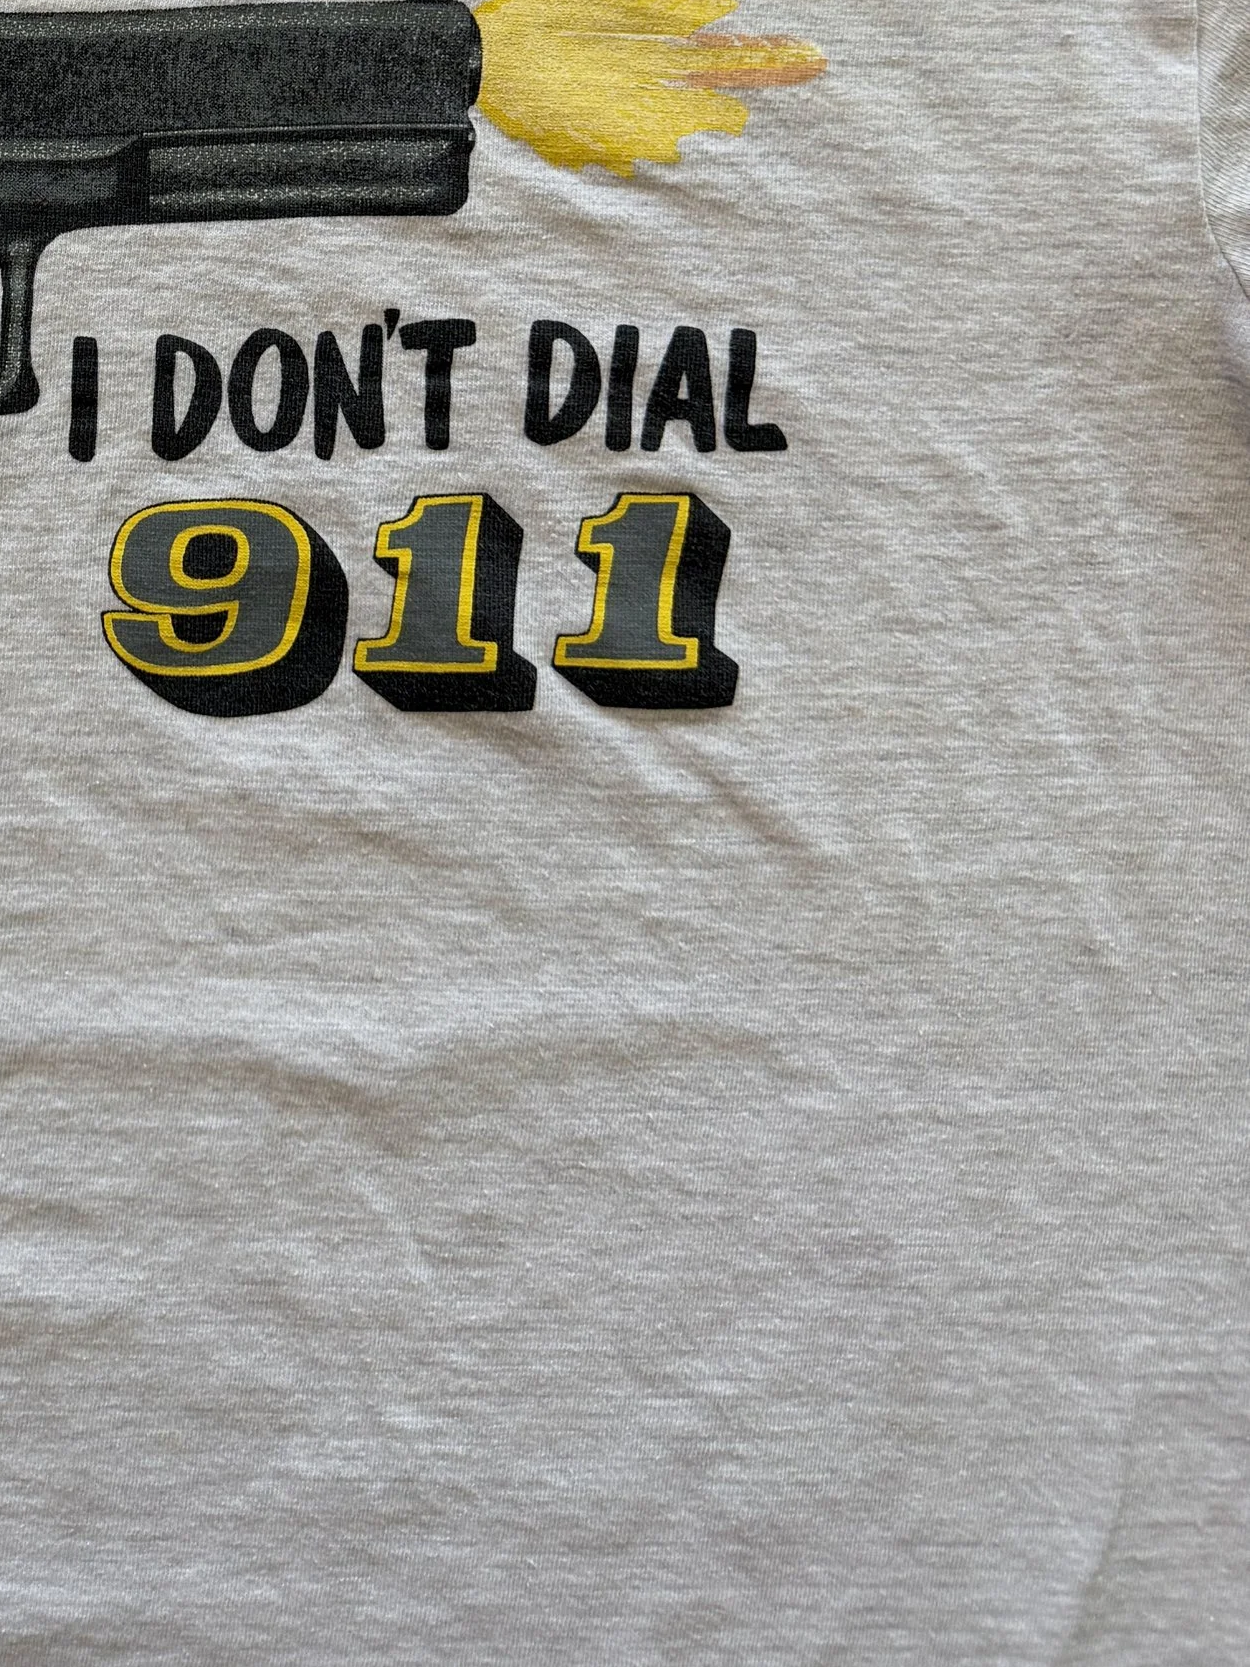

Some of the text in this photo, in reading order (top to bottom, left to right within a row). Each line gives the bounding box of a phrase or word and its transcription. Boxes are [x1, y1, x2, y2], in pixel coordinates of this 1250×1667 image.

[66, 308, 789, 463] I DON'T DIAL
[100, 491, 740, 718] 911
